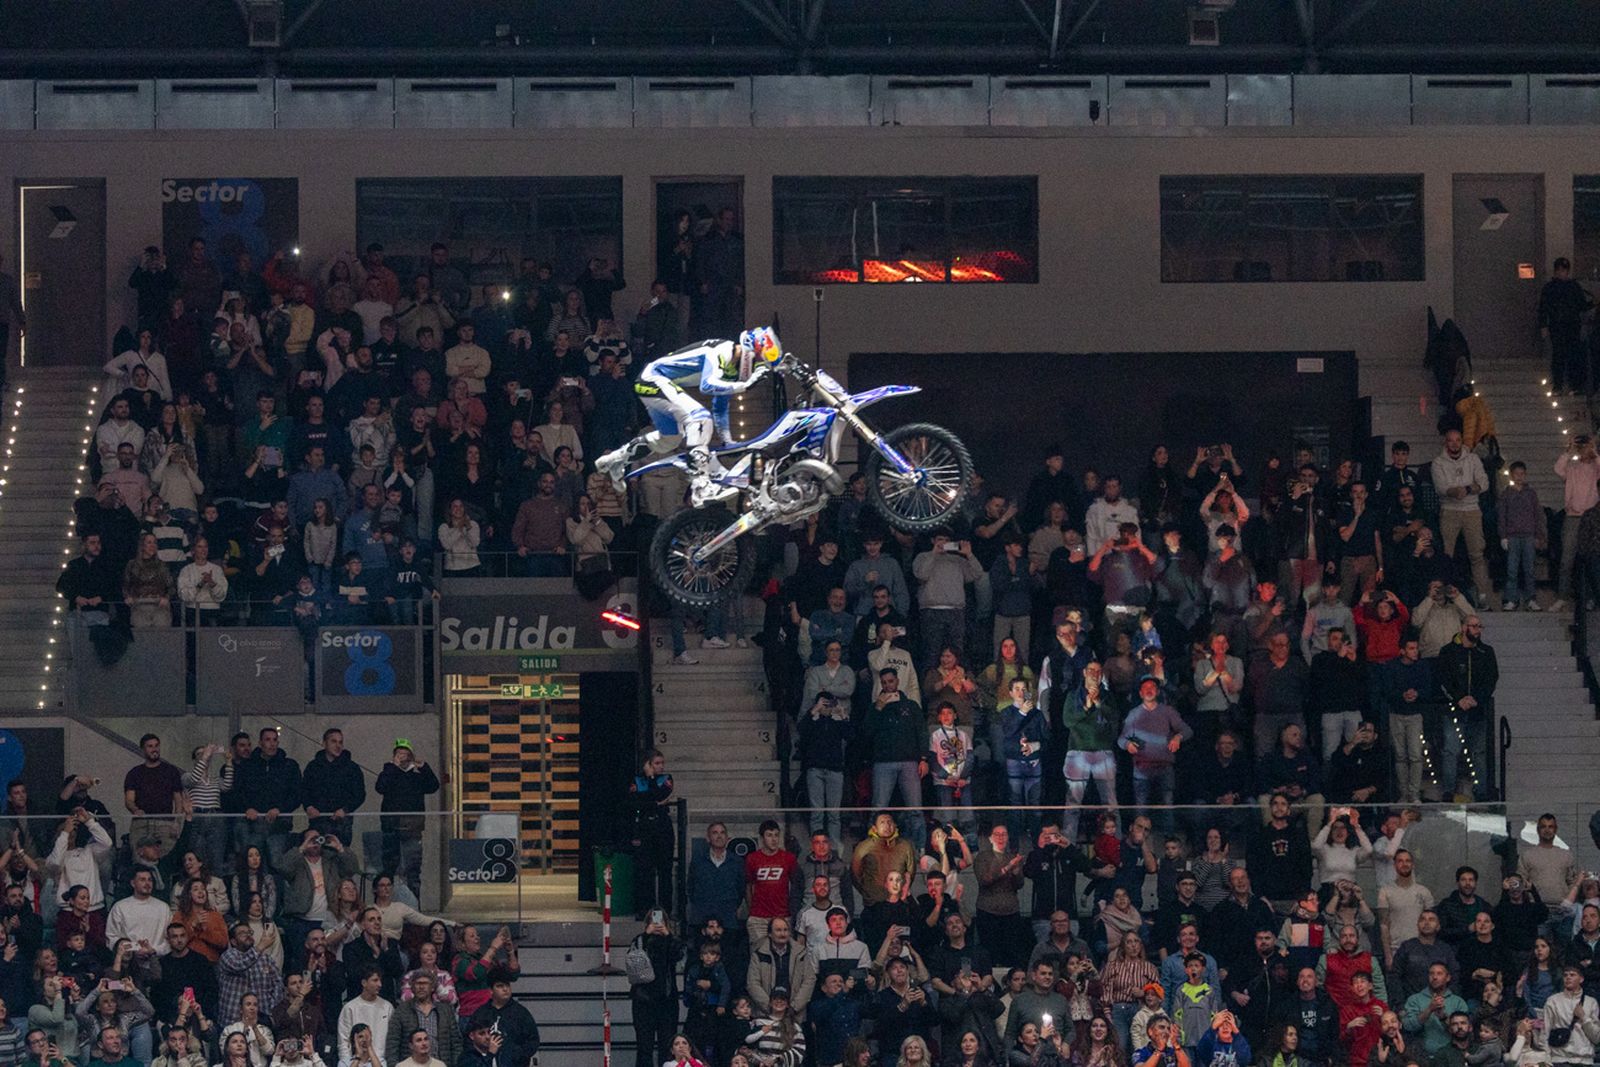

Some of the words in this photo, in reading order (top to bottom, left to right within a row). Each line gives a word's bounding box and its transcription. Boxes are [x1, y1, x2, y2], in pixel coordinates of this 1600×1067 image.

[162, 179, 249, 203] Sector
[197, 178, 268, 272] 8
[321, 631, 382, 648] Sector
[440, 614, 576, 650] Salida
[343, 628, 397, 696] 8
[521, 657, 558, 669] SALIDA
[480, 837, 517, 884] 8
[448, 867, 499, 881] Sector
[756, 867, 784, 881] 93
